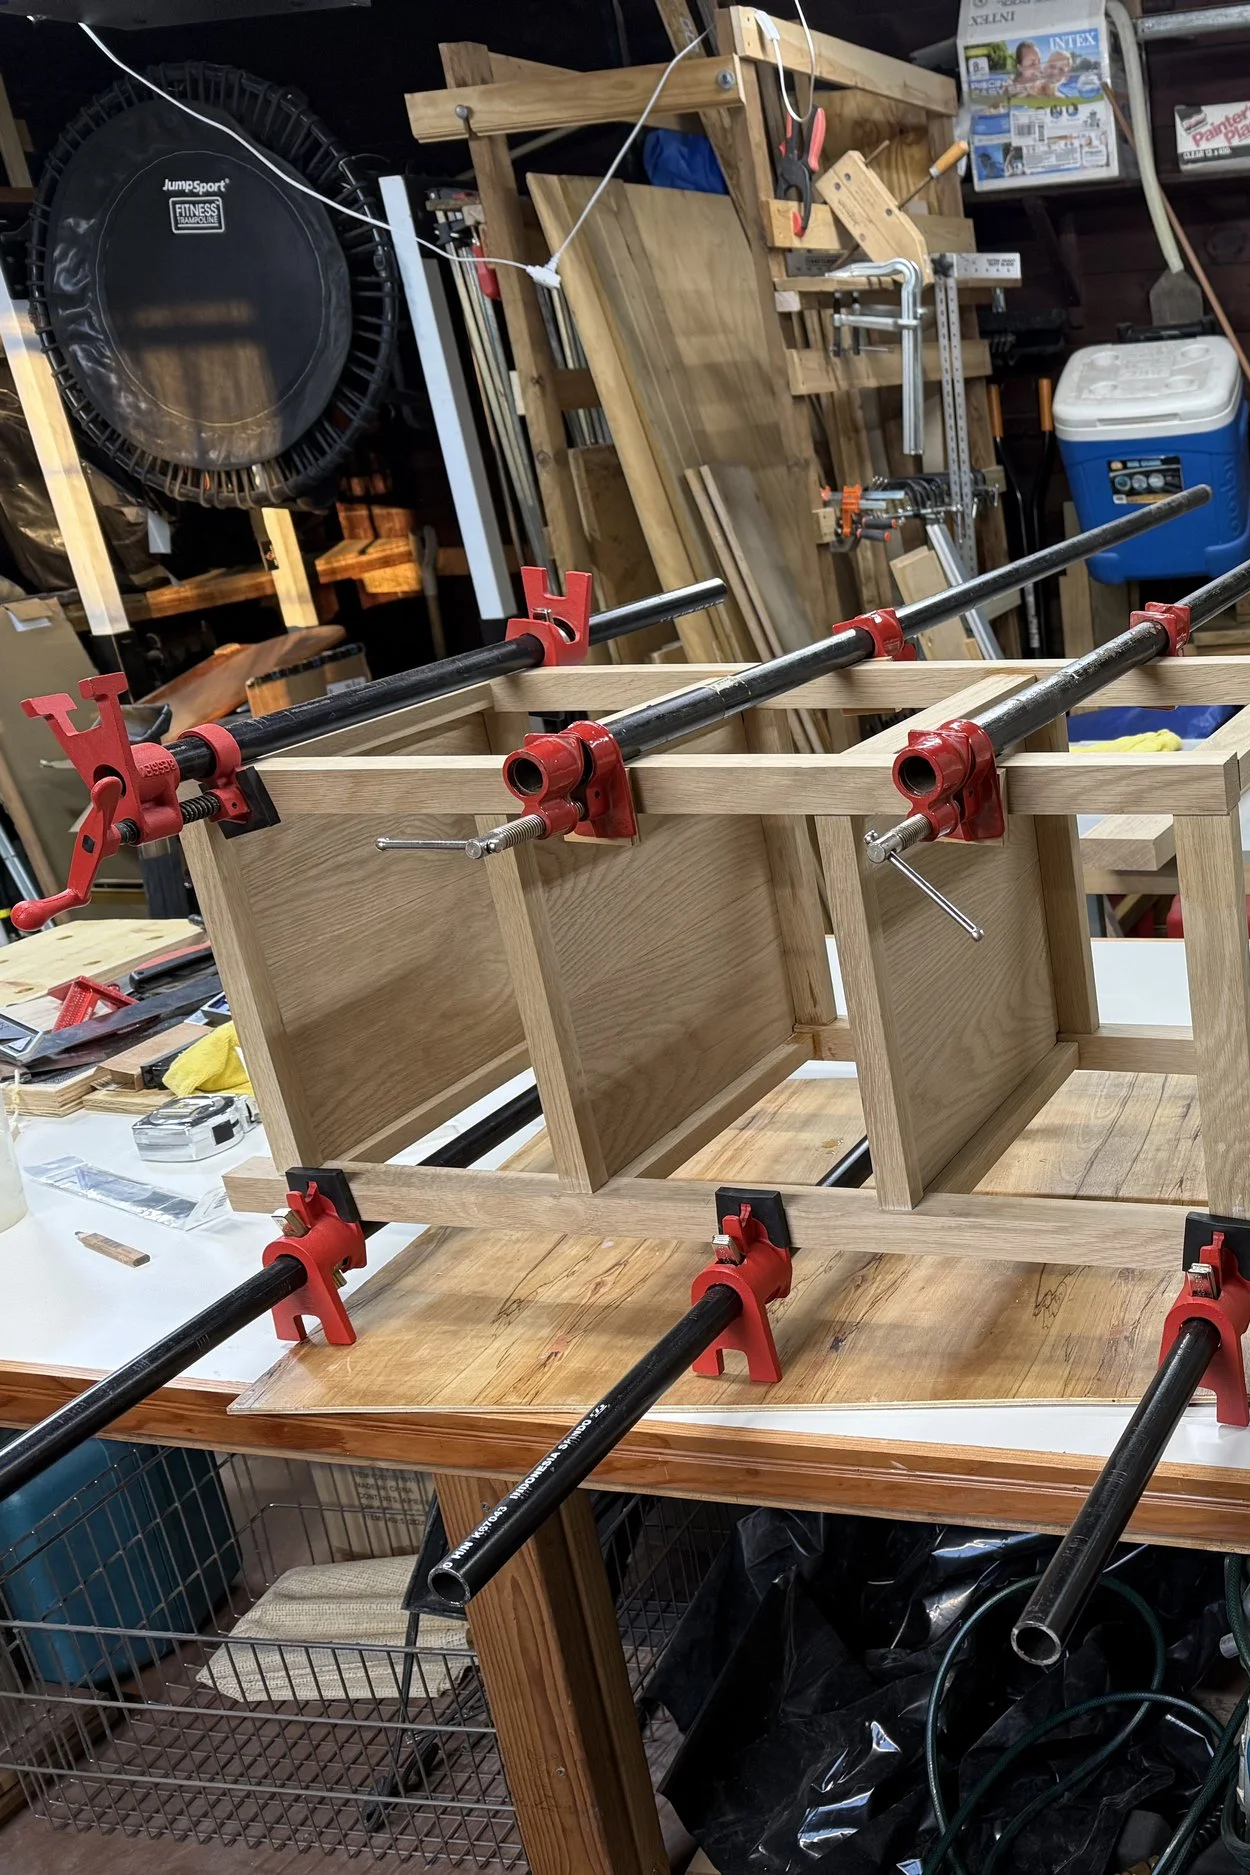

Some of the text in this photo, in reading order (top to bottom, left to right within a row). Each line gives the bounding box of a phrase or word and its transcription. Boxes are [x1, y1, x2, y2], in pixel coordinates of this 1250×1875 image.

[1050, 31, 1097, 50] INTEX
[162, 178, 226, 195] JumpSport
[175, 203, 218, 217] FITNESS
[176, 216, 219, 224] TRAMPOLINE
[509, 1451, 561, 1500] INDONESIA
[557, 1419, 592, 1451] SPINDO
